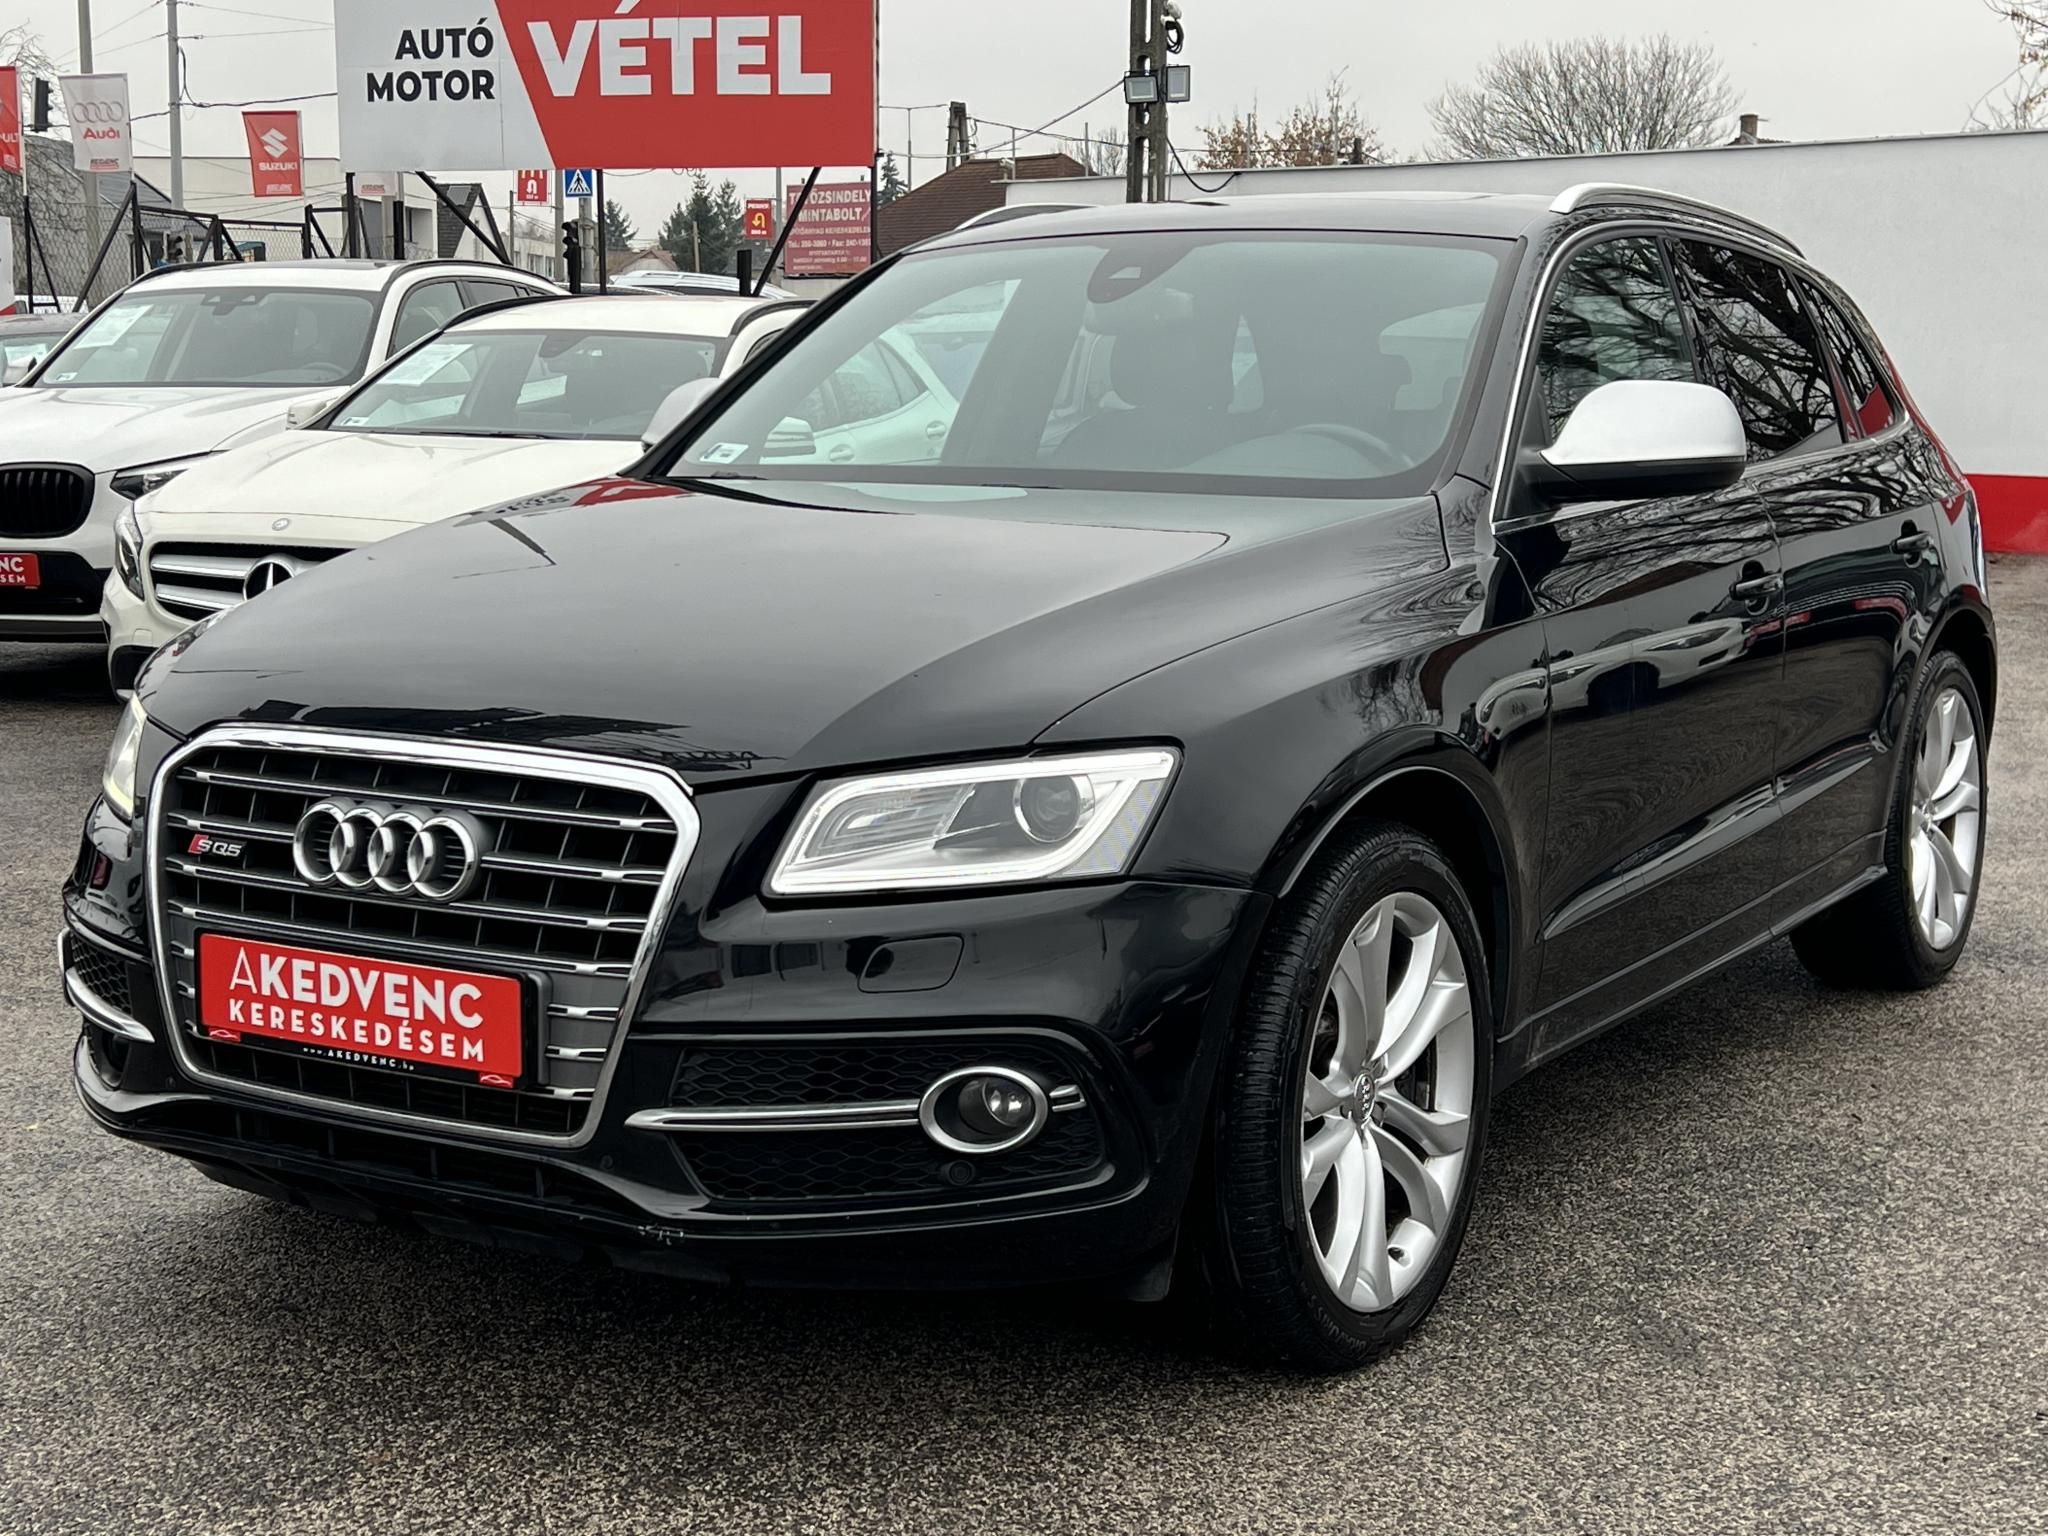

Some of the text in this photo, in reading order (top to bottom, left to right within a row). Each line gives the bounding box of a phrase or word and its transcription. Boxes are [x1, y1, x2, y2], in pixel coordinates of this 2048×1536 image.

[395, 17, 494, 60] AUTÓ
[526, 0, 831, 97] VÉTEL
[367, 69, 495, 102] MOTOR
[83, 127, 120, 139] Audi
[258, 162, 297, 171] SUZUKI
[196, 838, 243, 857] SQ5
[229, 998, 484, 1063] KERESKEDÉSEM
